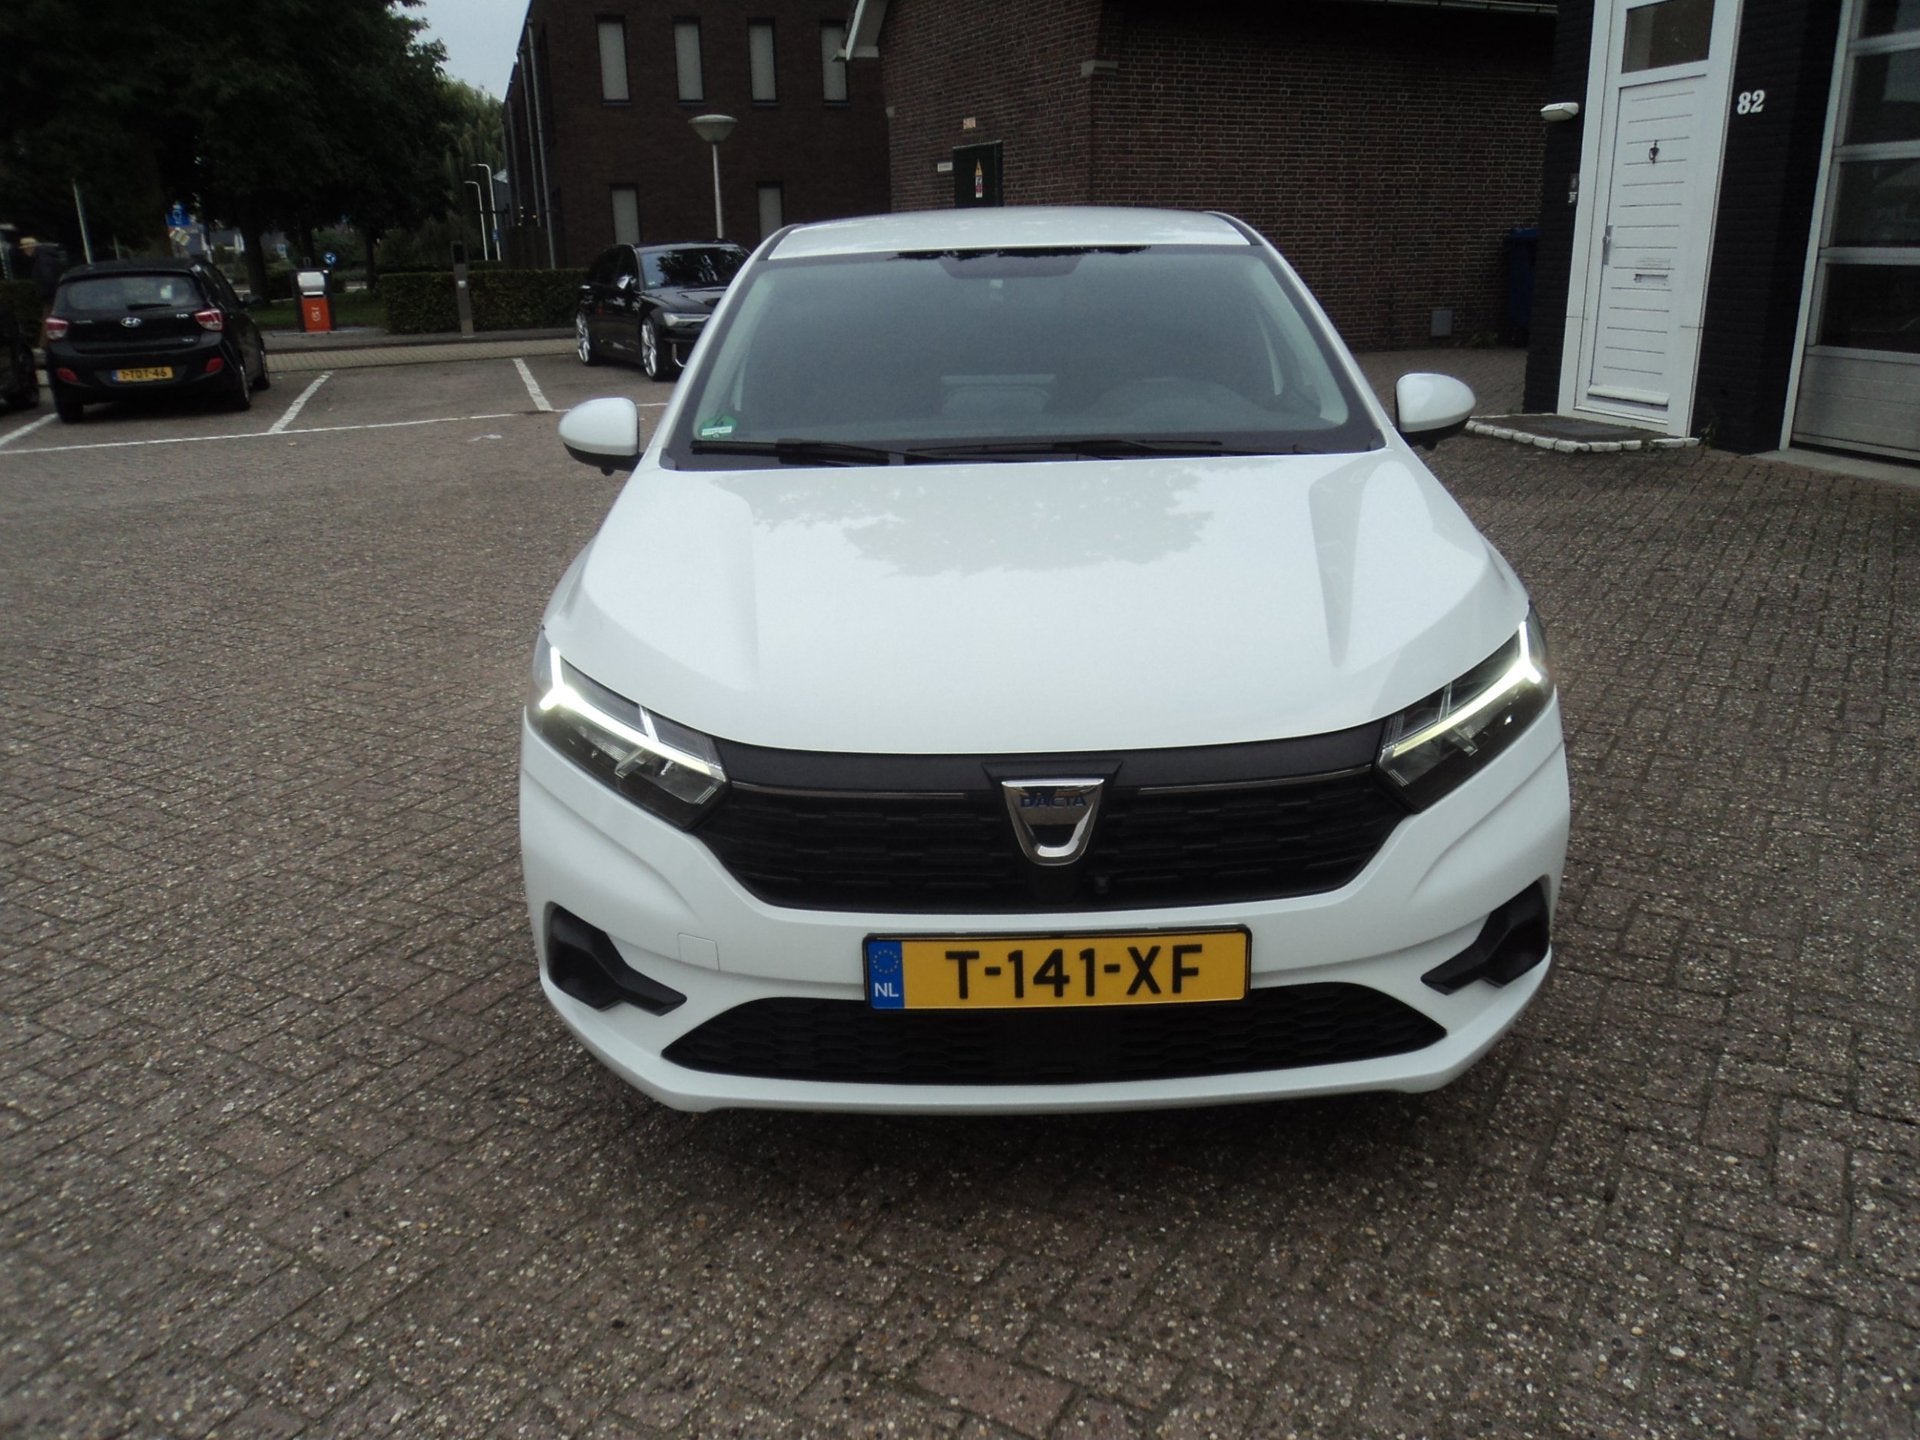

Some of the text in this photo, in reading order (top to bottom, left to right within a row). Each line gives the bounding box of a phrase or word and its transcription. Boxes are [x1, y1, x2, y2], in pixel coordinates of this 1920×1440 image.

[1737, 89, 1765, 115] 82
[1020, 797, 1087, 808] DACIA
[945, 944, 1203, 1000] T-141-XF
[874, 982, 899, 998] NL
